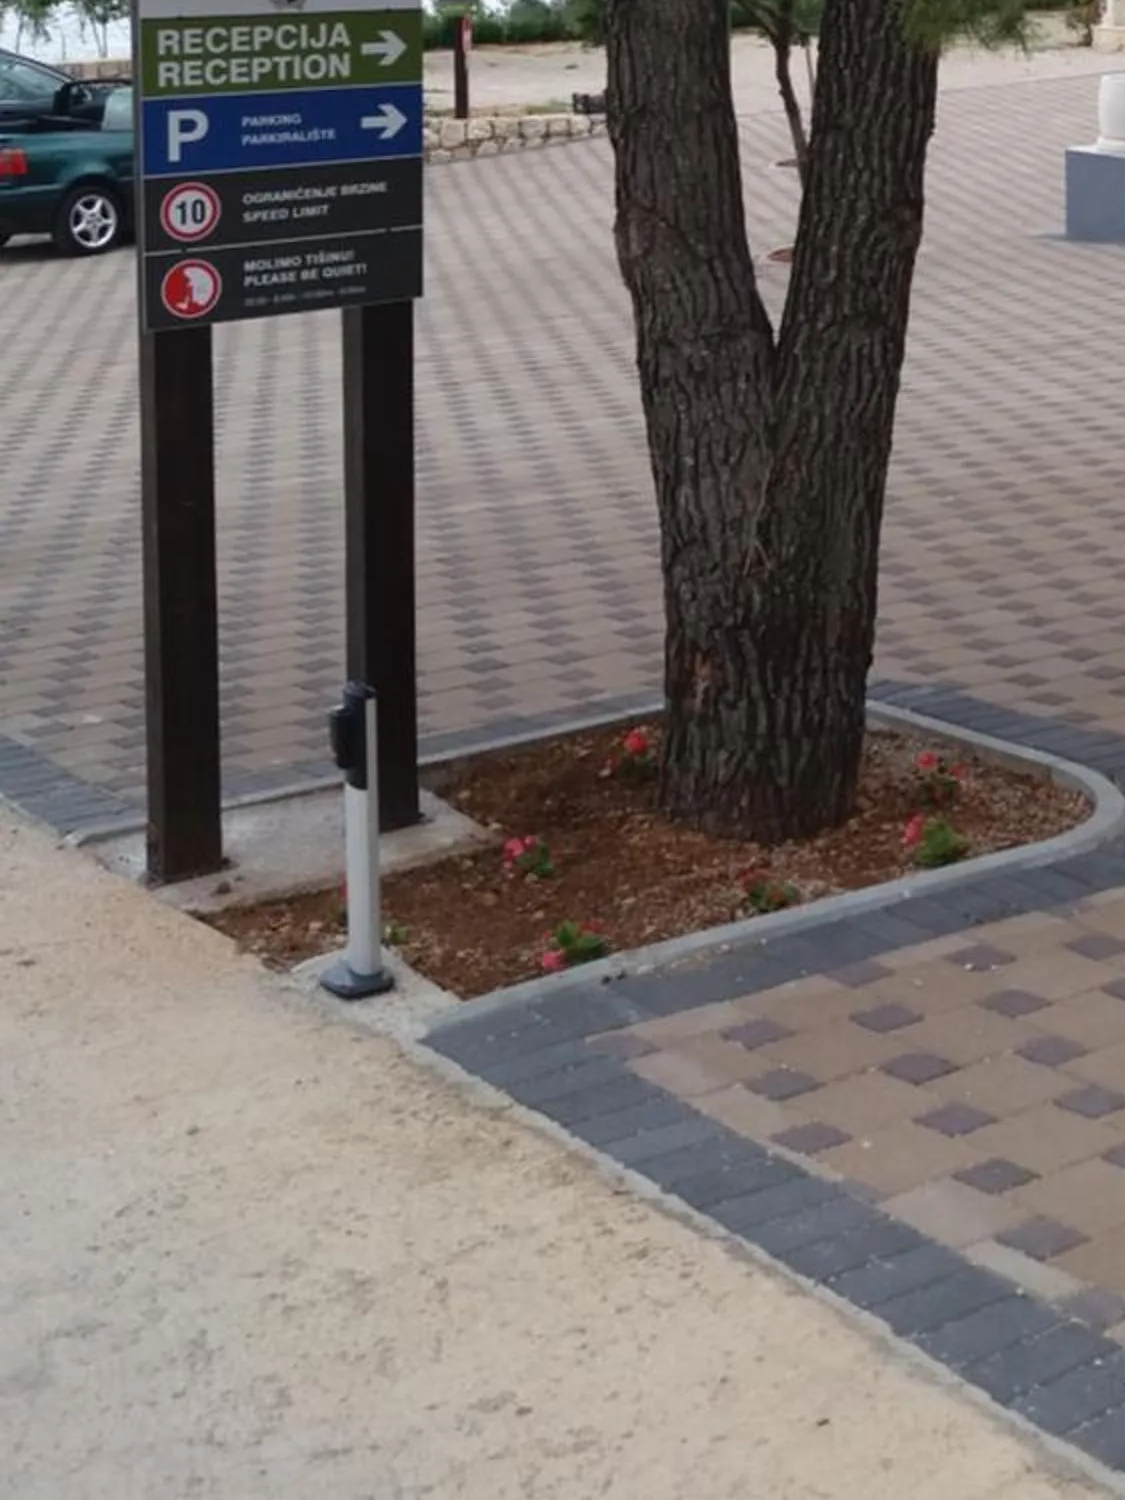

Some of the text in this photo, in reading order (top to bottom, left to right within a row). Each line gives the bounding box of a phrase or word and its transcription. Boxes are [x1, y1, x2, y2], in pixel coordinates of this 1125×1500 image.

[157, 22, 351, 55] RECEPCIJA
[157, 54, 350, 87] RECEPTION
[241, 113, 302, 127] PARKING
[167, 109, 209, 162] P
[241, 128, 336, 146] PARKIRALIŠTE
[174, 199, 206, 226] 10
[242, 204, 329, 222] SPEED LIMIT
[243, 256, 301, 272] MOLIMO
[243, 271, 297, 287] PLEASE
[300, 268, 319, 280] BE
